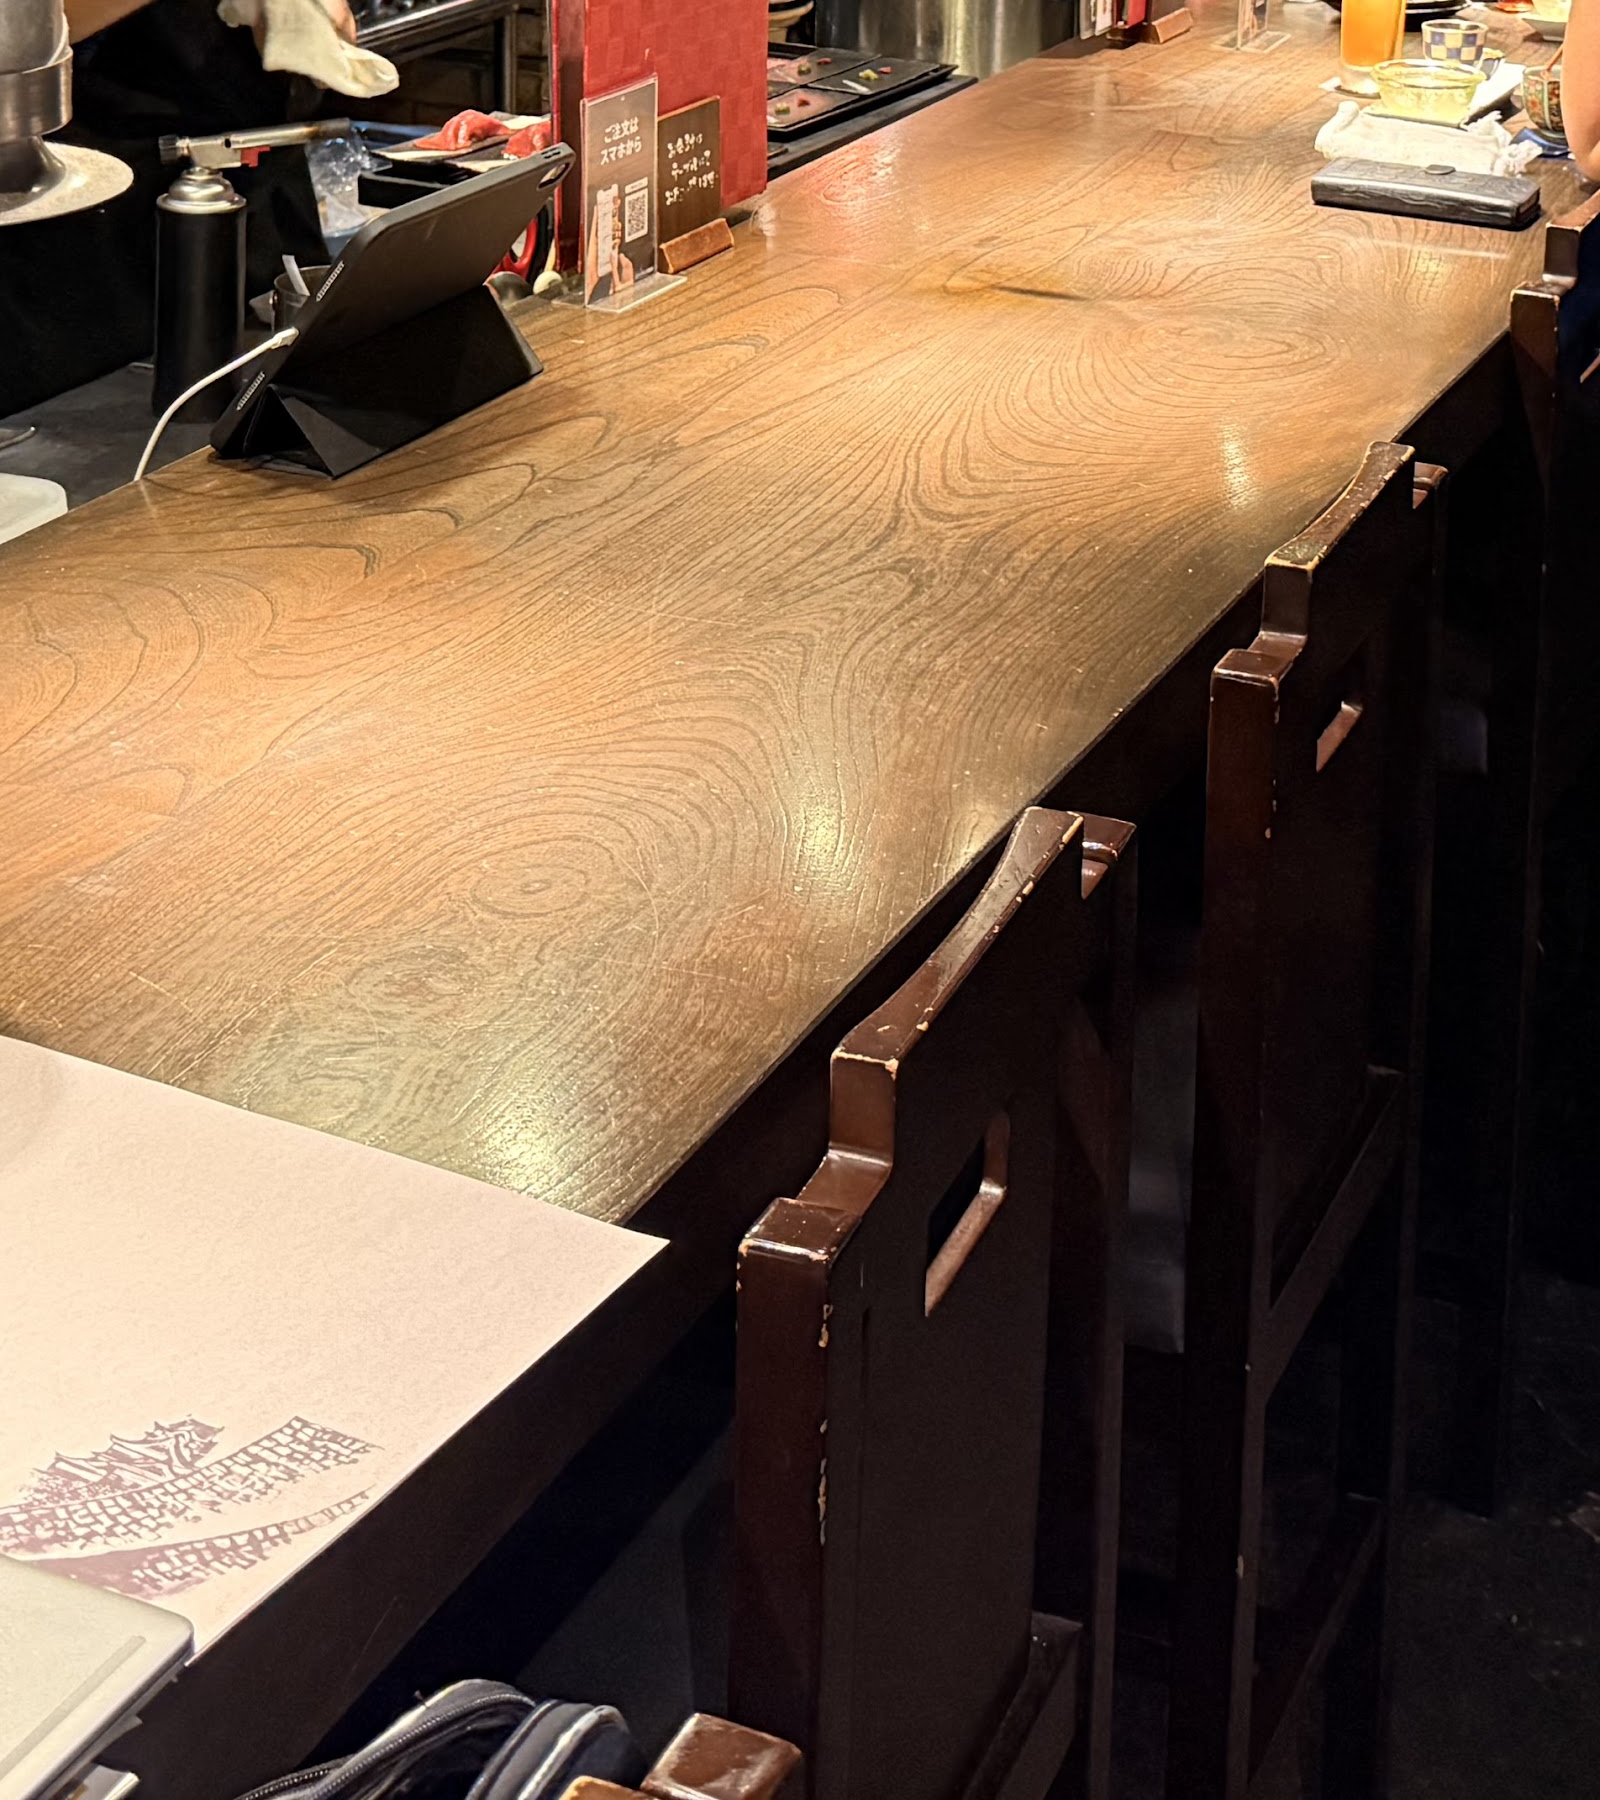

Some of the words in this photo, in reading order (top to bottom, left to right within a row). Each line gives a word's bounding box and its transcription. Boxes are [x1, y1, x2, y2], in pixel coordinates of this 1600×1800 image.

[604, 116, 639, 144] ご注文は
[600, 135, 643, 166] スマホから
